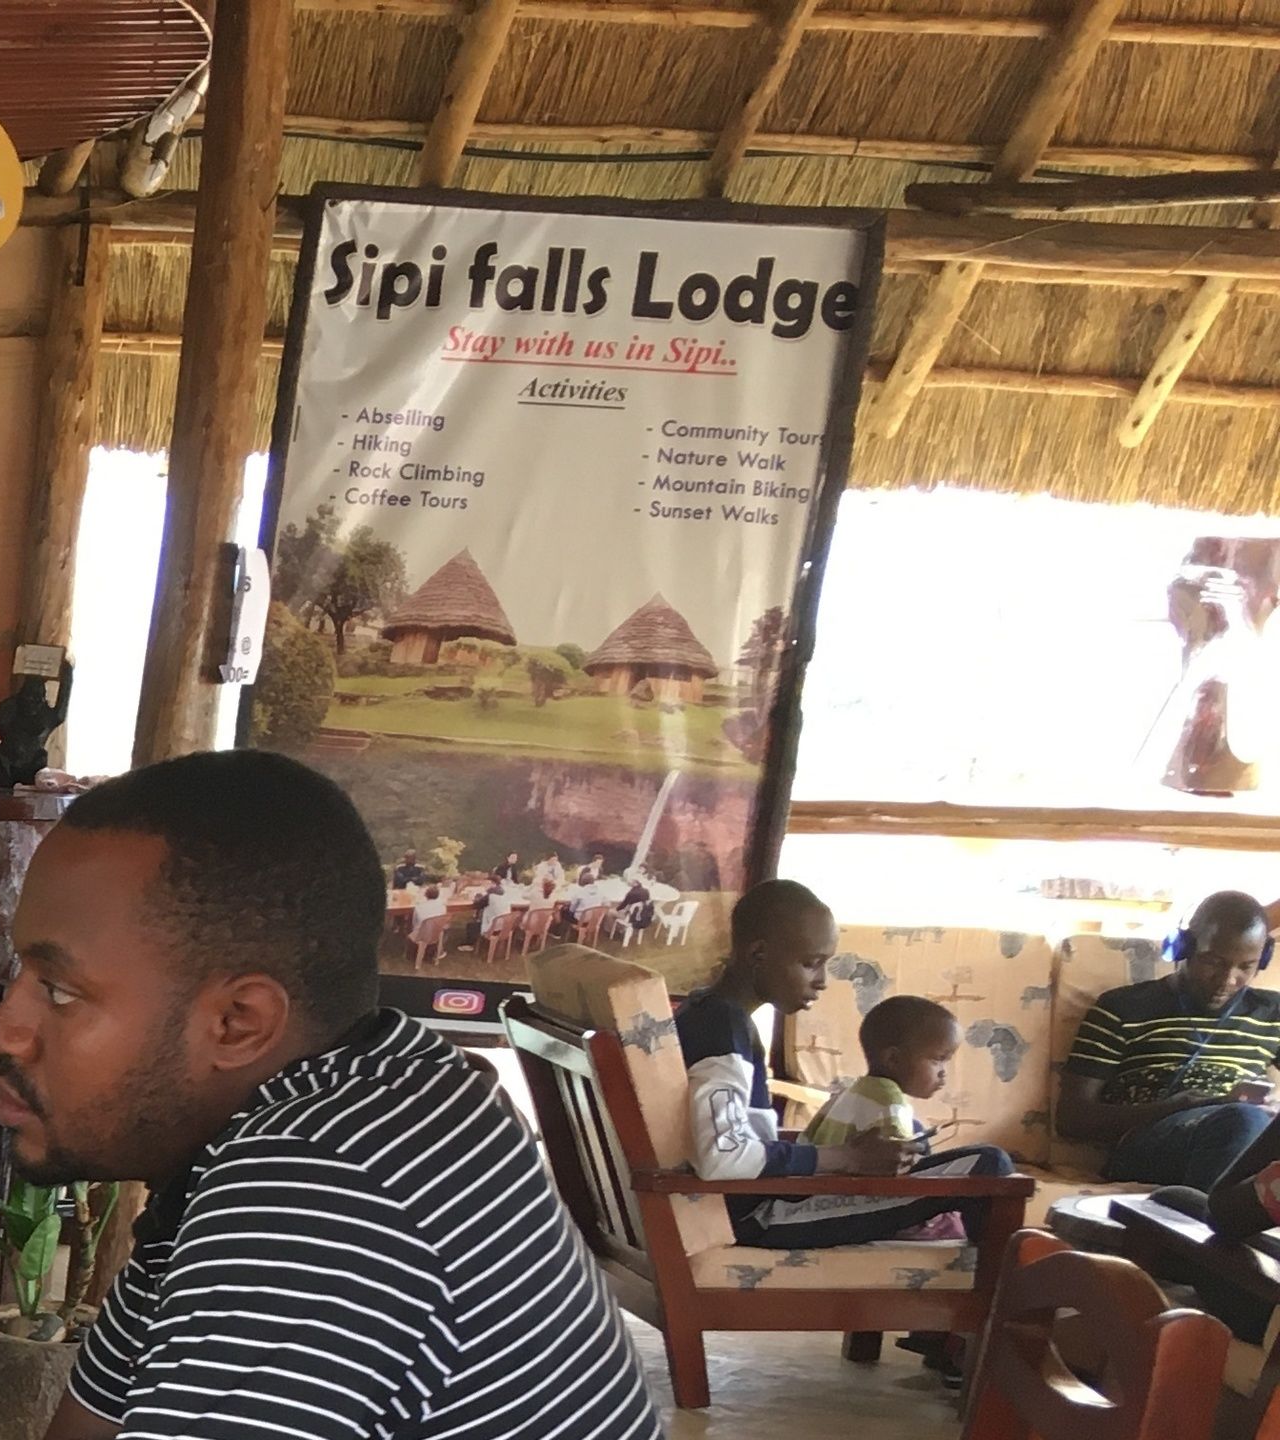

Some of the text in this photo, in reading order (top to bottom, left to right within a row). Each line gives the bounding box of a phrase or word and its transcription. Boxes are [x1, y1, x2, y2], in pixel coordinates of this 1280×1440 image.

[324, 239, 860, 339] Sipi falls Lodge
[442, 325, 505, 361] Stay
[514, 330, 575, 357] with
[584, 336, 618, 359] us
[625, 335, 655, 363] in
[518, 376, 628, 402] Activities
[356, 407, 445, 432] Abseiling
[352, 434, 412, 457] Hiking
[661, 420, 769, 446] Community
[657, 448, 786, 471] Nature Walk
[348, 461, 485, 488] Rock Climbing
[344, 487, 468, 510] Coffee Tours
[652, 475, 811, 504] Mountain Biking
[649, 501, 779, 525] Sunset Walks
